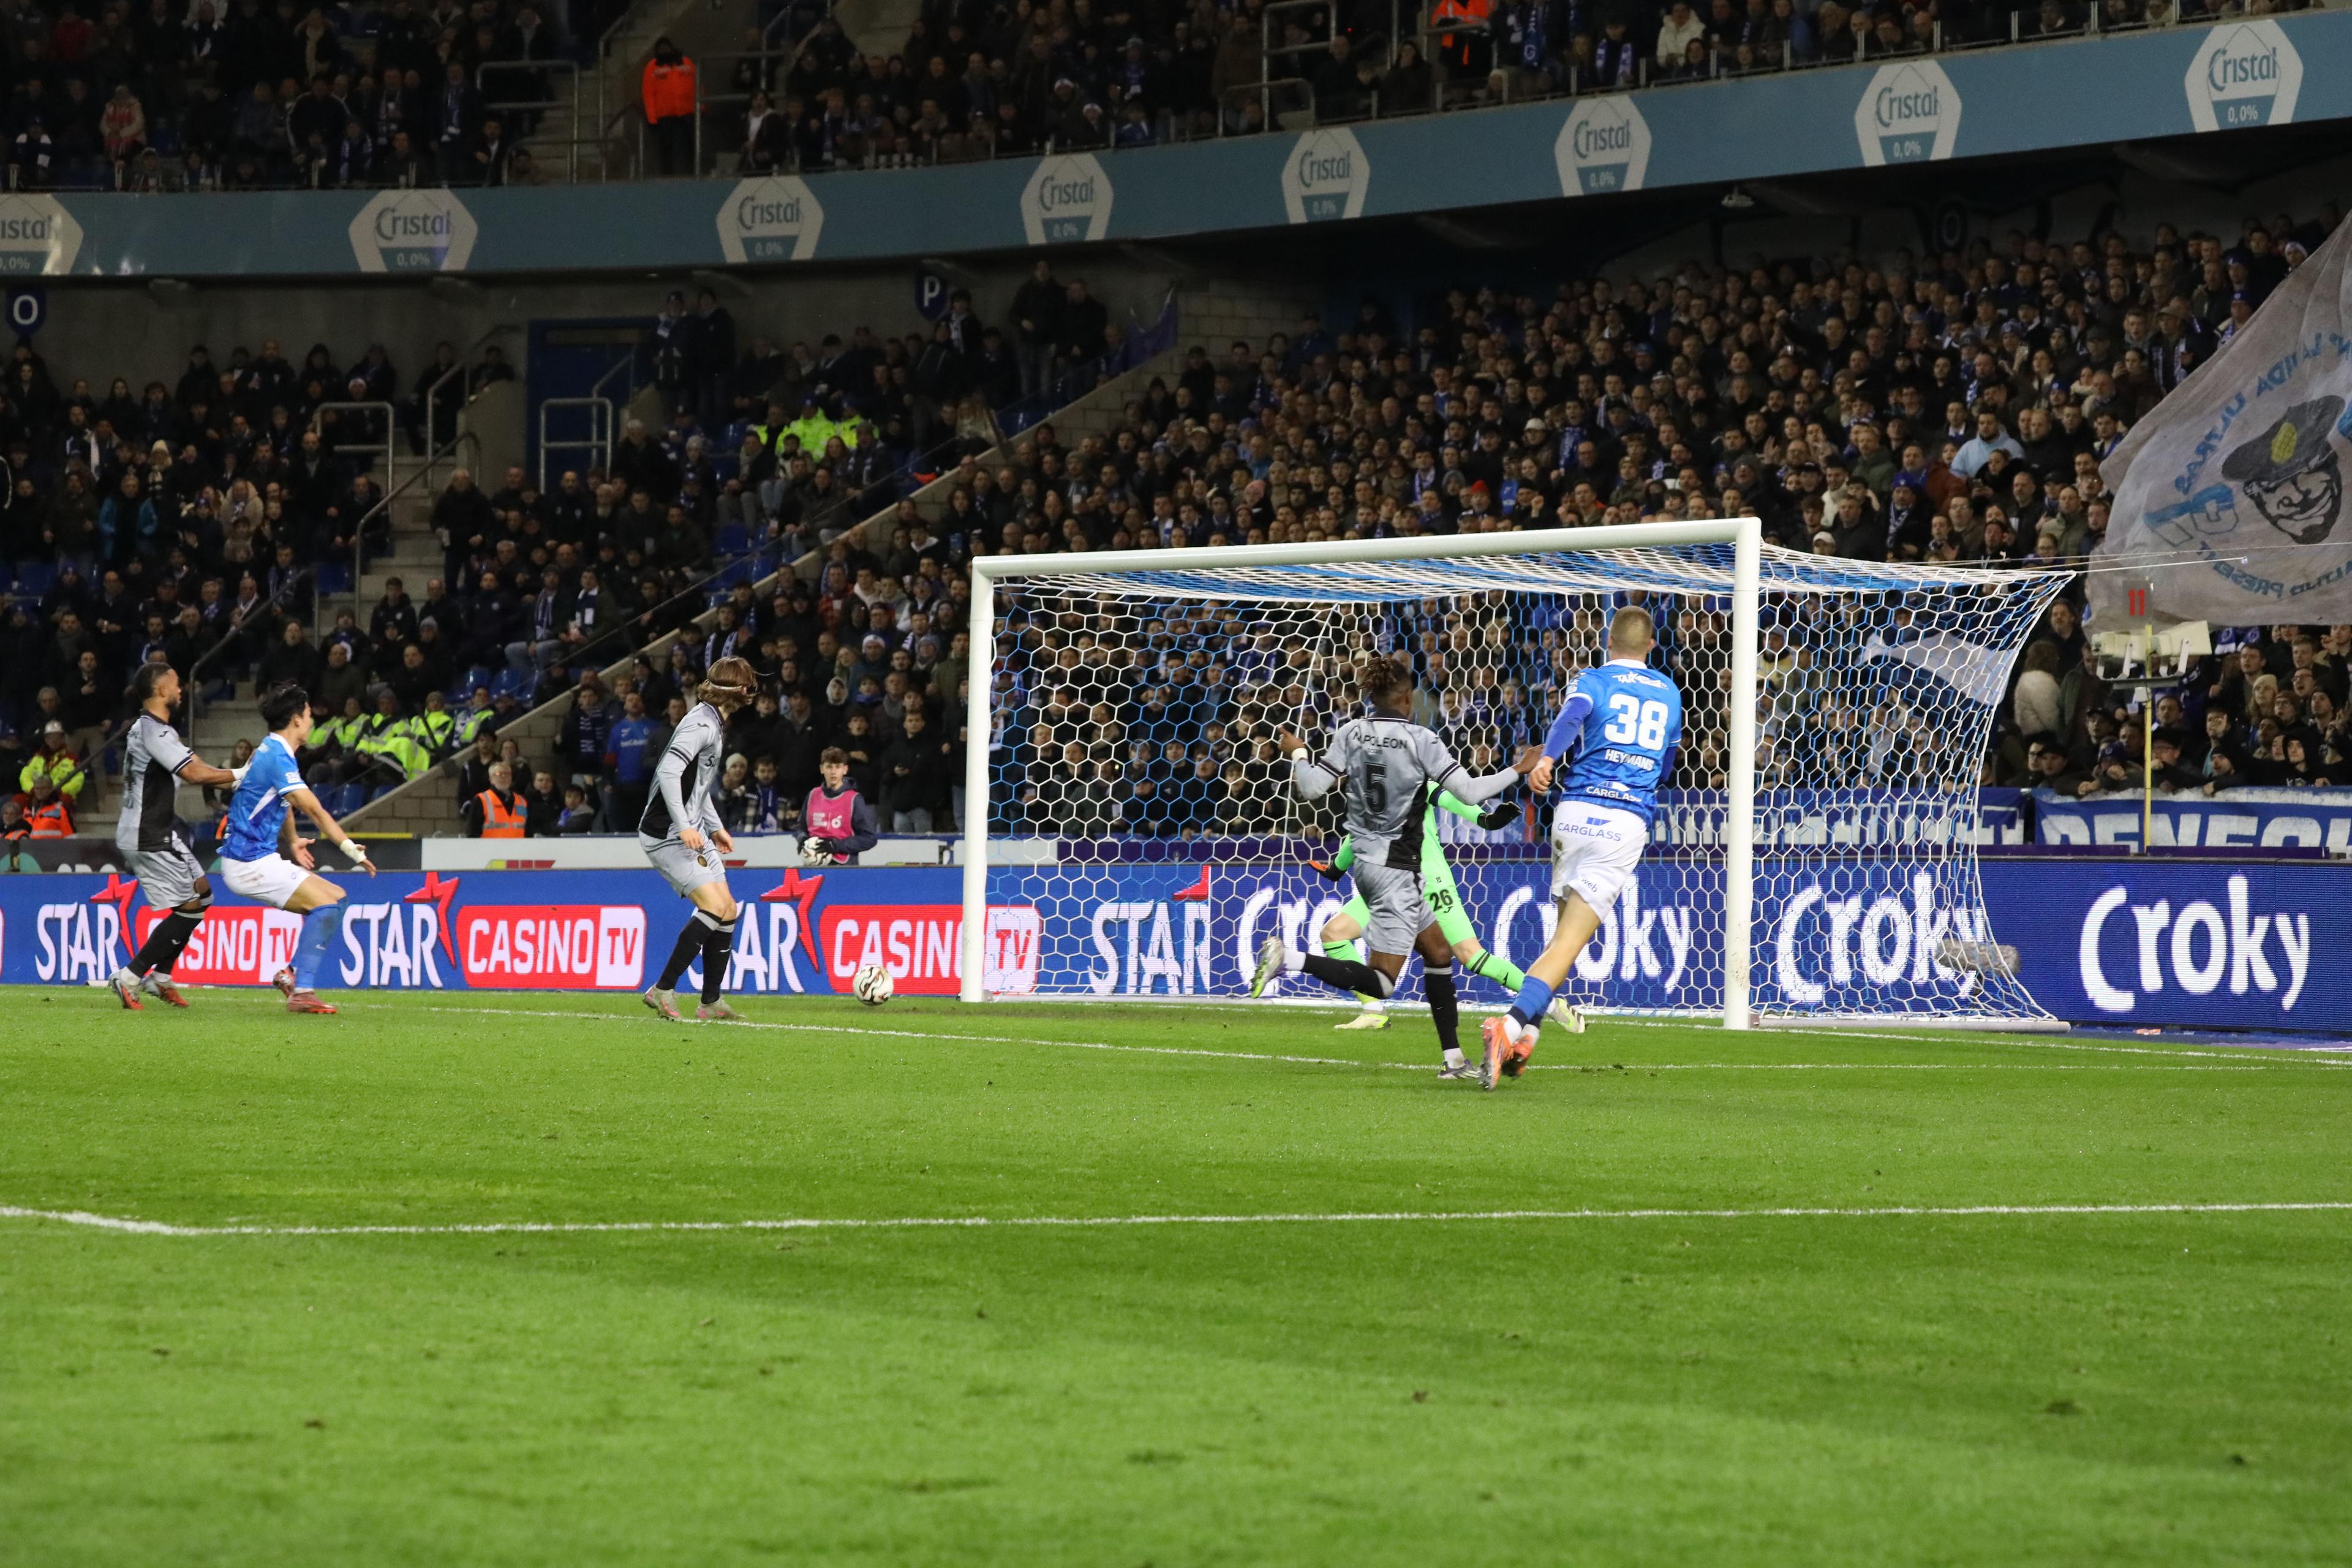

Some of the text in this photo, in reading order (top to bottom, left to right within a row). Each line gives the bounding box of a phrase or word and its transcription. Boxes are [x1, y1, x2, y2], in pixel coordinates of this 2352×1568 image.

[2209, 47, 2277, 91] Cristal
[1875, 86, 1938, 127] Cristal
[2228, 105, 2258, 123] 0,0%
[1574, 119, 1630, 159] Cristal
[1300, 150, 1351, 187] Cristal
[1039, 175, 1094, 210] Cristal
[374, 206, 451, 241] Cristal
[739, 196, 801, 230] Cristal
[13, 294, 39, 325] O
[924, 276, 940, 307] P
[2127, 589, 2146, 617] 11
[1604, 693, 1668, 751] 38
[1353, 732, 1408, 749] NPOLEON
[1605, 749, 1655, 771] HEYMANS
[1364, 762, 1387, 815] 5
[1558, 822, 1622, 842] CARGLASS
[1430, 889, 1453, 911] 26
[1581, 878, 1598, 893] web
[35, 902, 119, 981] STAR
[269, 927, 299, 963] TV
[339, 902, 638, 987] STAR CASINO TV
[834, 919, 963, 979] CASIN
[995, 929, 1031, 970] TV
[1087, 899, 1211, 995] STAR
[1777, 870, 1985, 1004] Croky
[2079, 873, 2310, 1012] Croky
